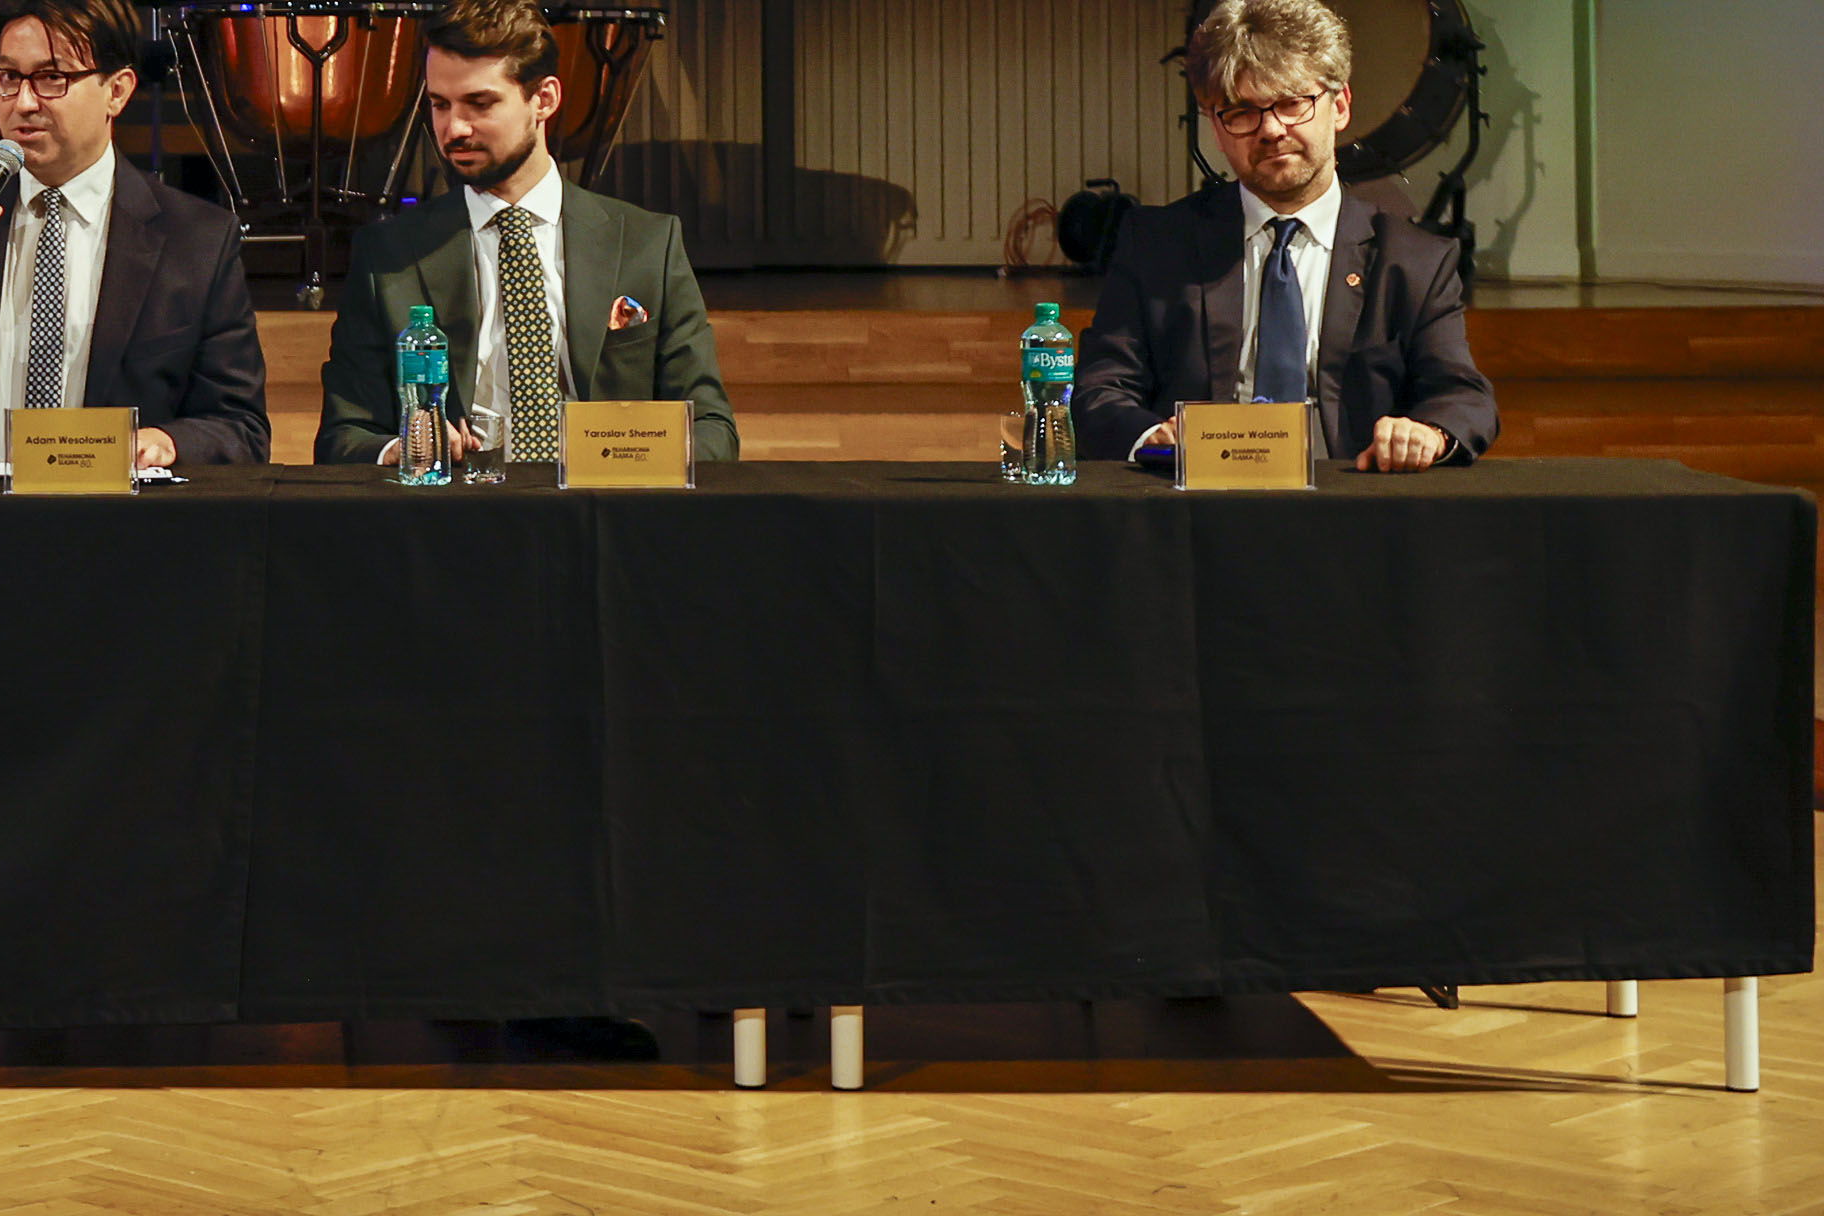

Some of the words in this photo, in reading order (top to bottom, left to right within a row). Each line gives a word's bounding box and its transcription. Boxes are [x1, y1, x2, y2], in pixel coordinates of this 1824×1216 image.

[584, 429, 627, 439] Yaroslav
[628, 428, 668, 438] Shemet
[25, 435, 57, 445] Adam
[58, 435, 116, 445] Wesołowski
